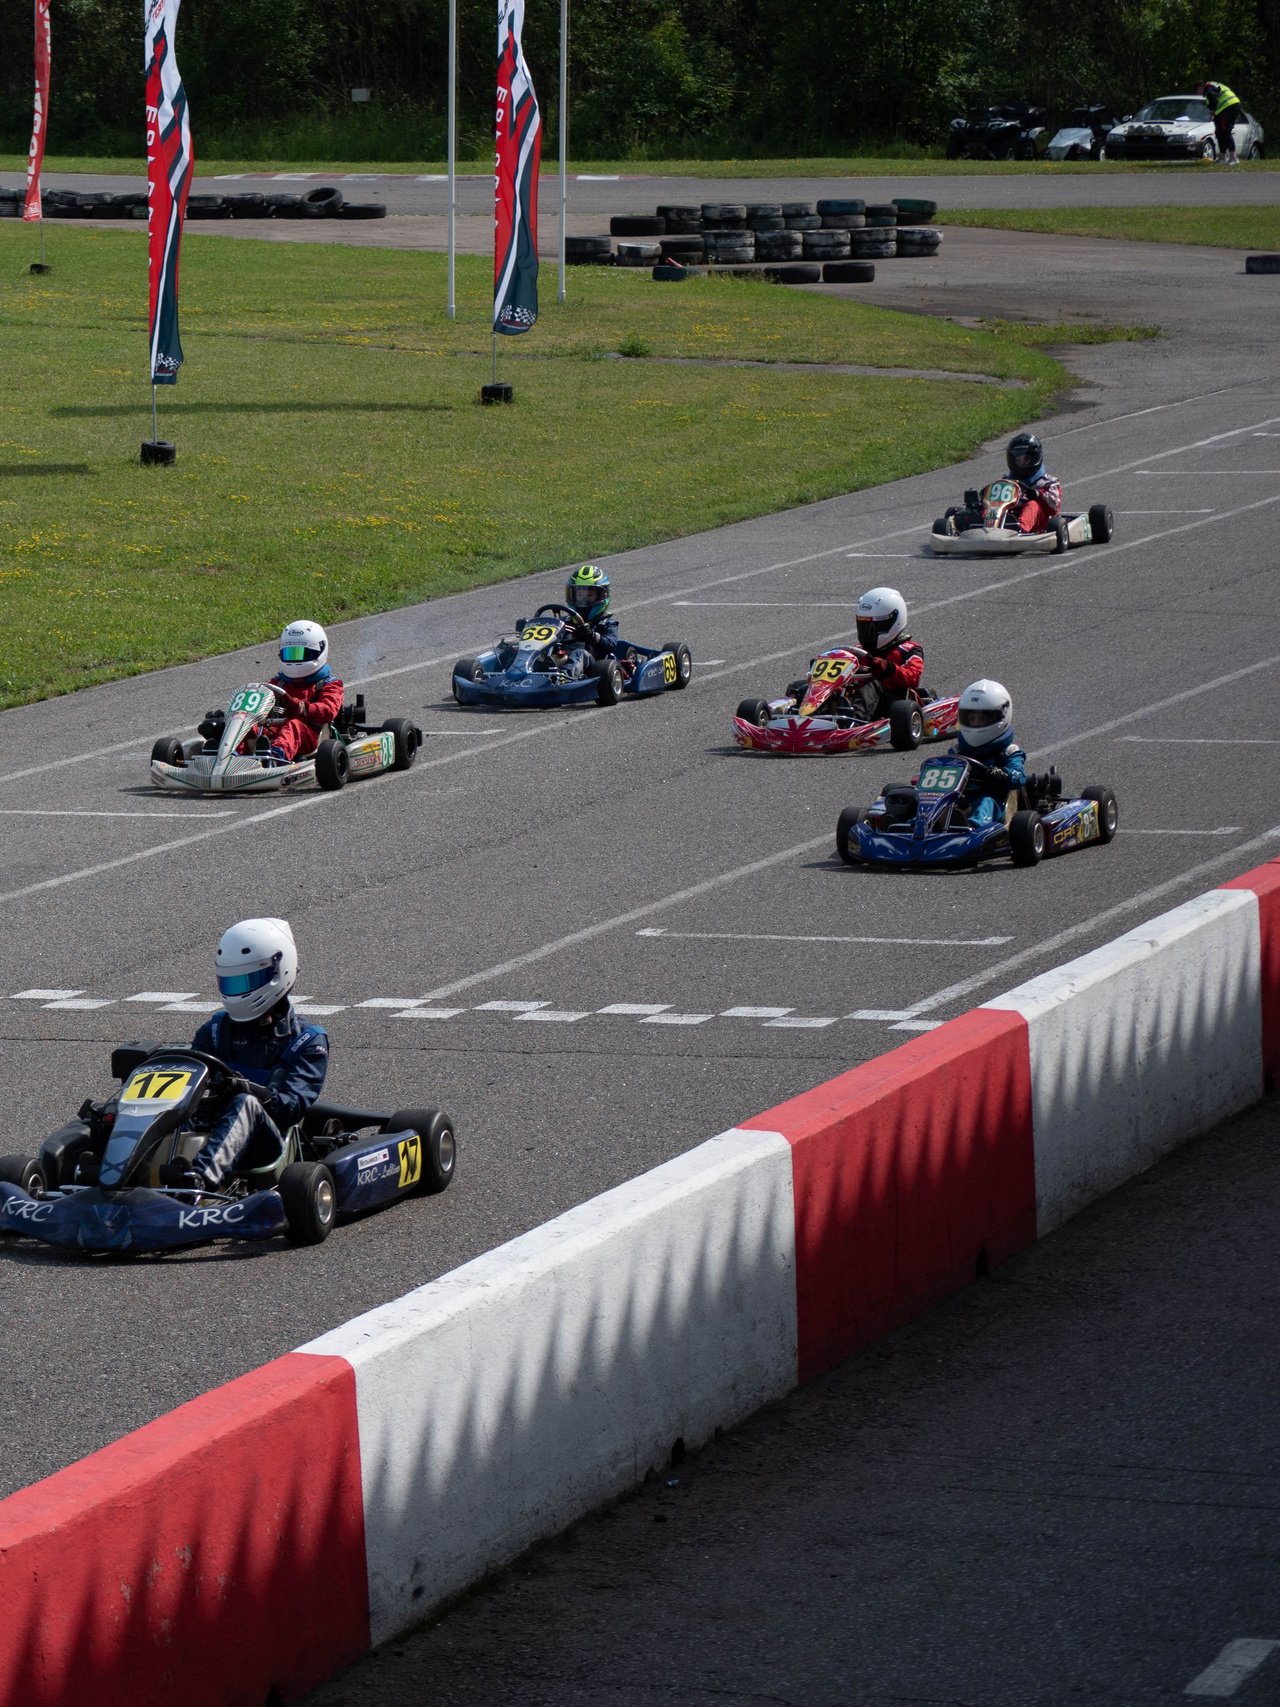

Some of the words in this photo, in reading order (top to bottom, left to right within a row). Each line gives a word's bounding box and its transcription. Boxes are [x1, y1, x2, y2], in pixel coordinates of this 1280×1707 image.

[990, 483, 1013, 501] 96
[520, 627, 553, 641] 69
[665, 655, 676, 682] 69
[813, 661, 845, 678] 95
[231, 692, 261, 712] 89
[921, 769, 957, 788] 85
[134, 1073, 185, 1099] 17
[401, 1138, 418, 1183] 17
[1, 1196, 54, 1222] KRC
[178, 1203, 245, 1229] KRC
